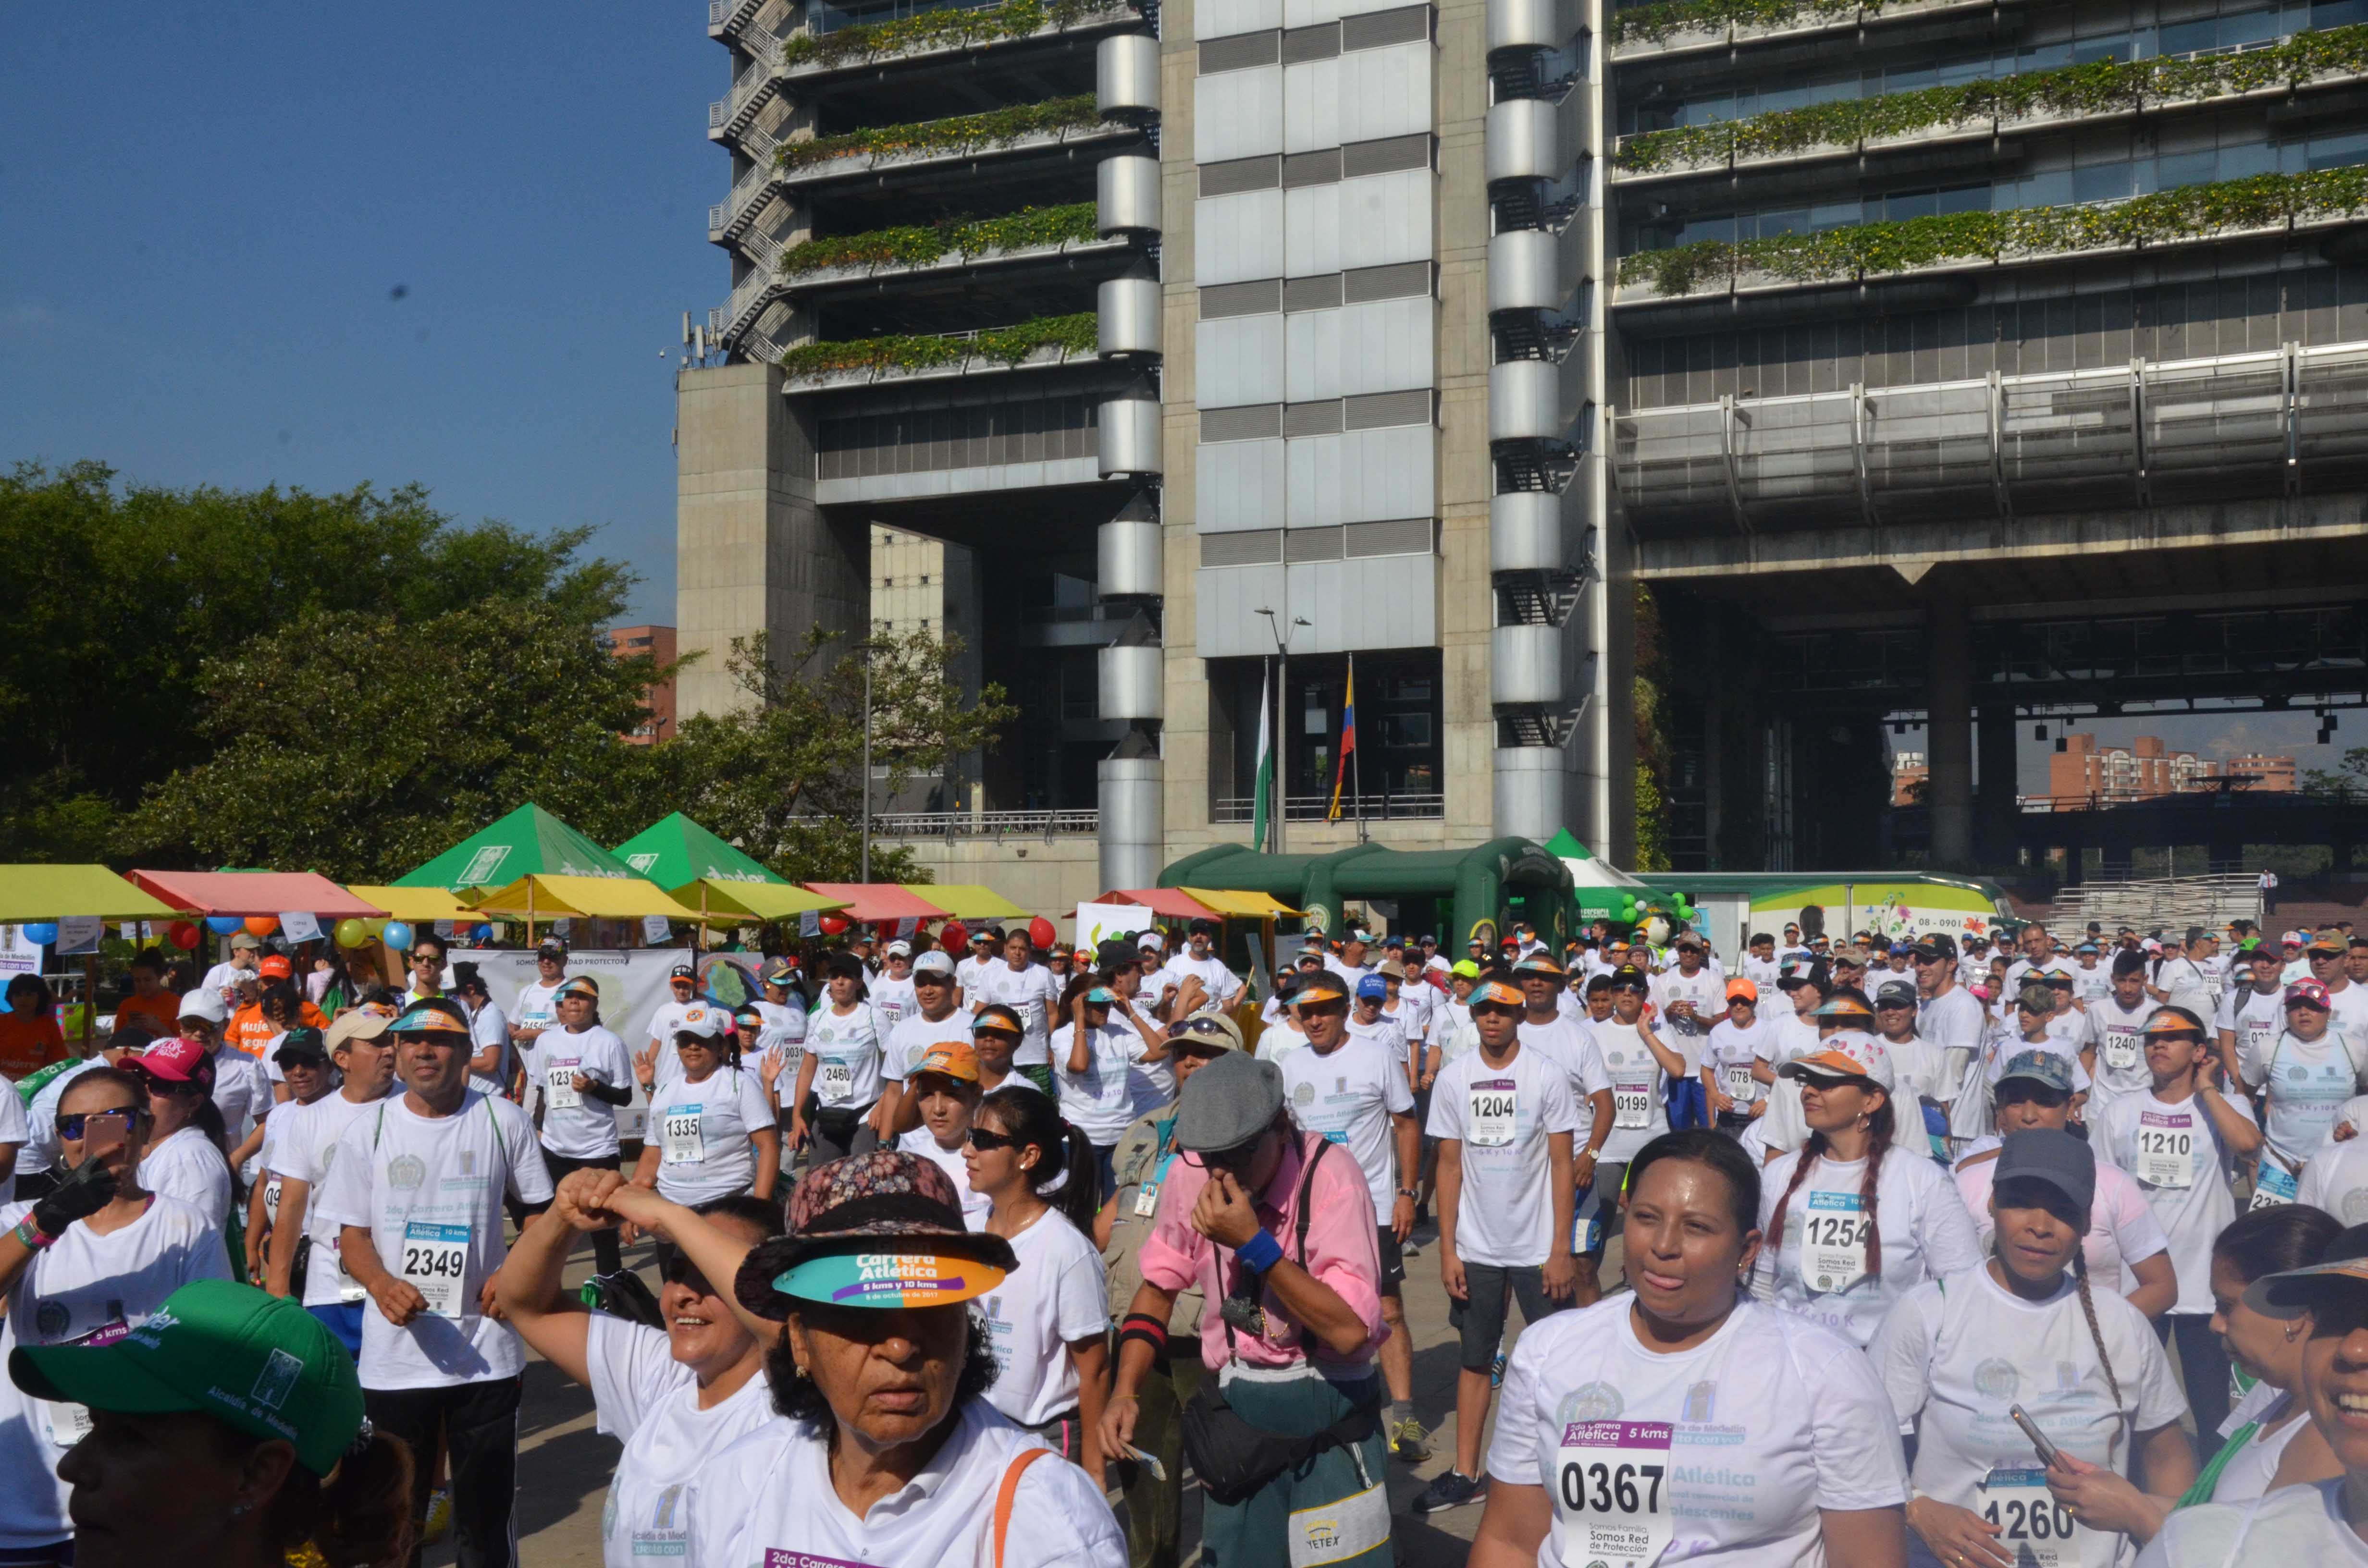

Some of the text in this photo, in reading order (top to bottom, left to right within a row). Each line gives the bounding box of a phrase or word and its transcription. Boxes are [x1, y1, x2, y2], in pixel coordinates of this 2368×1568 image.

[1940, 919, 1961, 927] 0901
[2108, 1036, 2135, 1050] 1240
[785, 1047, 803, 1058] 0031
[549, 1070, 575, 1086] 1231
[826, 1067, 850, 1081] 2460
[1730, 1071, 1753, 1083] 0781
[1472, 1096, 1514, 1117] 1204
[1617, 1096, 1647, 1111] 0199
[666, 1118, 698, 1137] 1335
[2141, 1132, 2190, 1155] 1210
[411, 1203, 454, 1213] Carrera
[1812, 1199, 1845, 1207] Atlética
[410, 1228, 440, 1237] Atlética
[1808, 1217, 1872, 1249] 1254
[404, 1248, 464, 1278] 2349
[856, 1254, 937, 1268] Carrera
[859, 1264, 937, 1281] Atlética
[863, 1283, 870, 1291] 5
[872, 1281, 894, 1290] kms
[895, 1282, 902, 1290] y
[917, 1281, 938, 1289] kms
[1822, 1313, 1838, 1326] 10
[1844, 1314, 1854, 1326] K
[105, 1326, 127, 1338] kms
[208, 1385, 247, 1410] Alcaldía
[250, 1407, 264, 1418] de
[1568, 1427, 1669, 1441] Atlética 5 kms
[1703, 1424, 1746, 1433] Medellín
[1672, 1466, 1756, 1486] Atlética
[1562, 1461, 1664, 1514] 0367
[1691, 1492, 1740, 1502] comercial
[1985, 1499, 2074, 1540] 1260
[1589, 1522, 1649, 1534] Somos Familia,
[657, 1530, 686, 1541] de Med
[1591, 1531, 1649, 1544] Somos Red
[664, 1544, 683, 1554] con
[1590, 1542, 1648, 1553] de Protección
[772, 1552, 846, 1568] 2da Carrera
